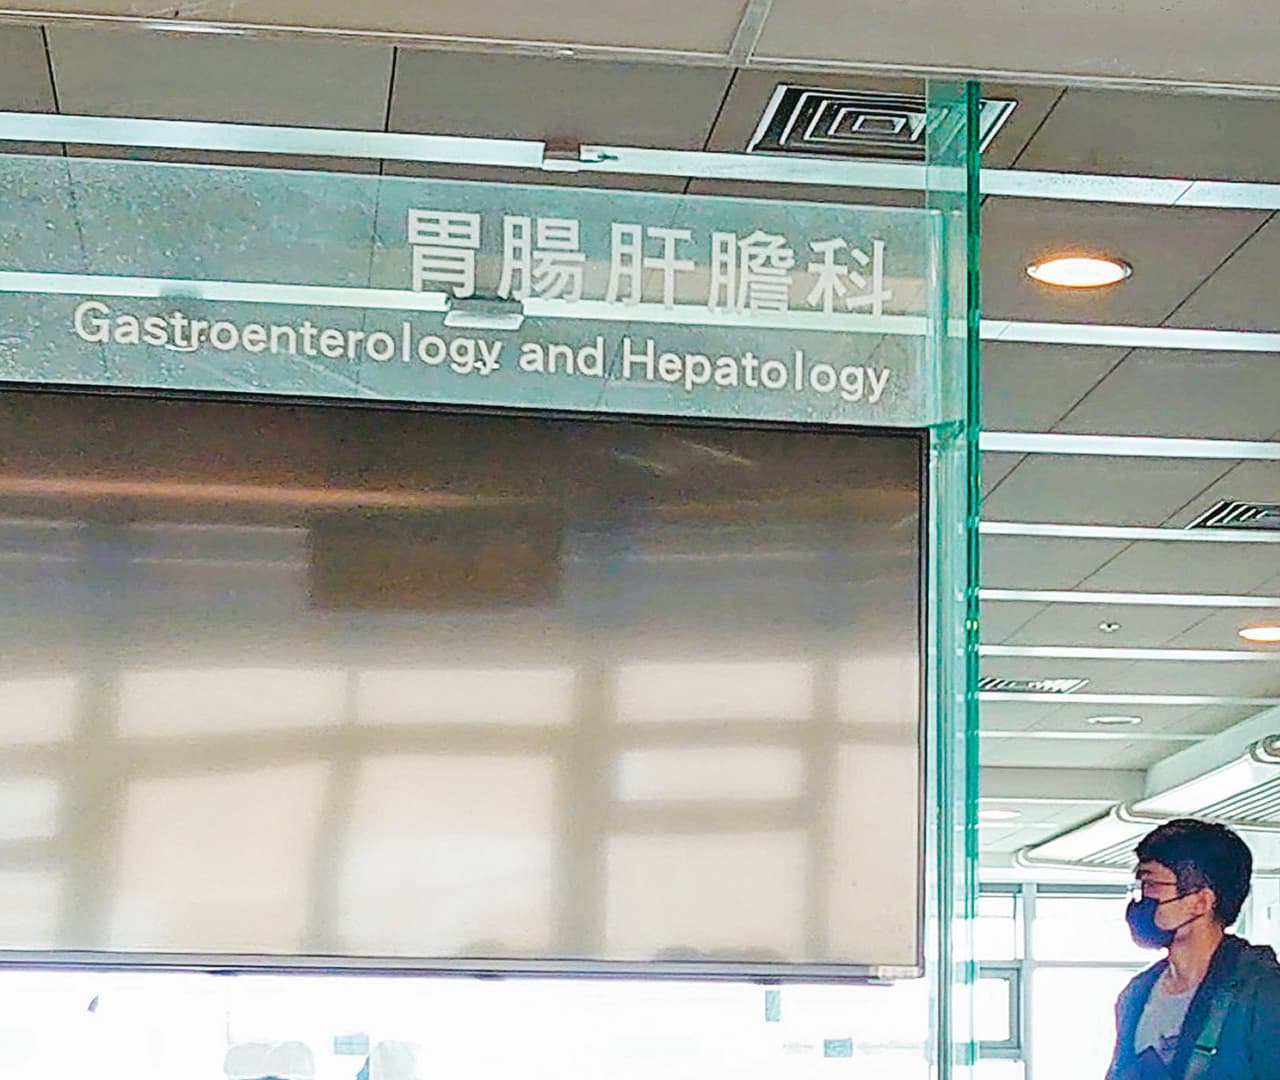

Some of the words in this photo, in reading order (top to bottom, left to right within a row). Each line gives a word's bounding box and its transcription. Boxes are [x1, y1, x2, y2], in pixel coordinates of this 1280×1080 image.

[408, 208, 893, 320] 胃腸肝膽科
[74, 301, 502, 375] Gastroenterology
[520, 337, 604, 377] and
[622, 337, 891, 402] Hepatology
